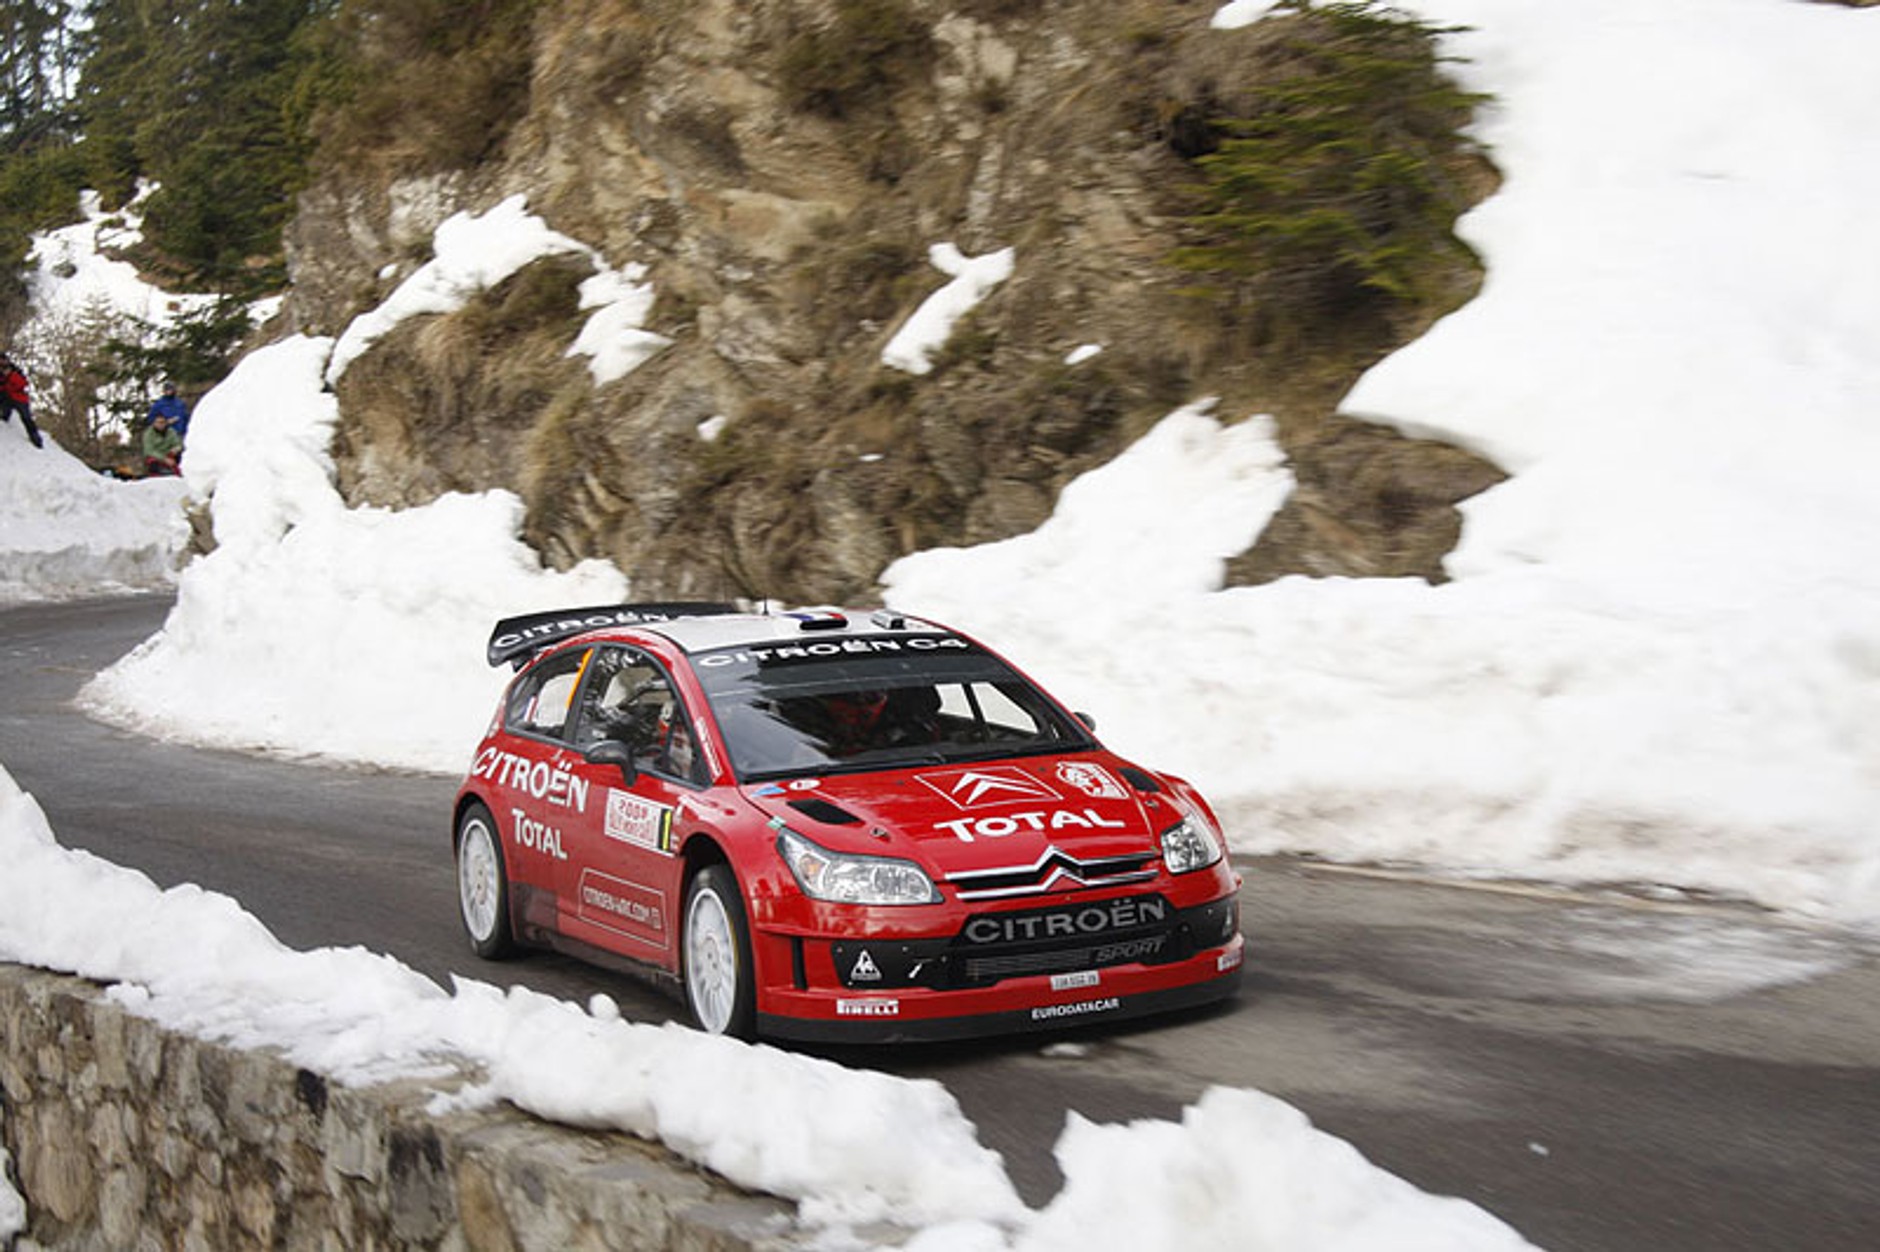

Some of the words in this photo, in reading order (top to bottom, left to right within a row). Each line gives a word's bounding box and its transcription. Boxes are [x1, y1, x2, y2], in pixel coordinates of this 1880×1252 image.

[494, 611, 669, 647] CITROËN
[700, 639, 901, 667] CITROËN
[907, 638, 968, 650] C4
[472, 746, 589, 813] CITROËN
[511, 807, 569, 860] TOTAL
[932, 809, 1126, 843] TOTAL
[965, 898, 1166, 944] CITROËN
[1096, 935, 1168, 963] SPORT
[1031, 998, 1120, 1020] EURODATACAR
